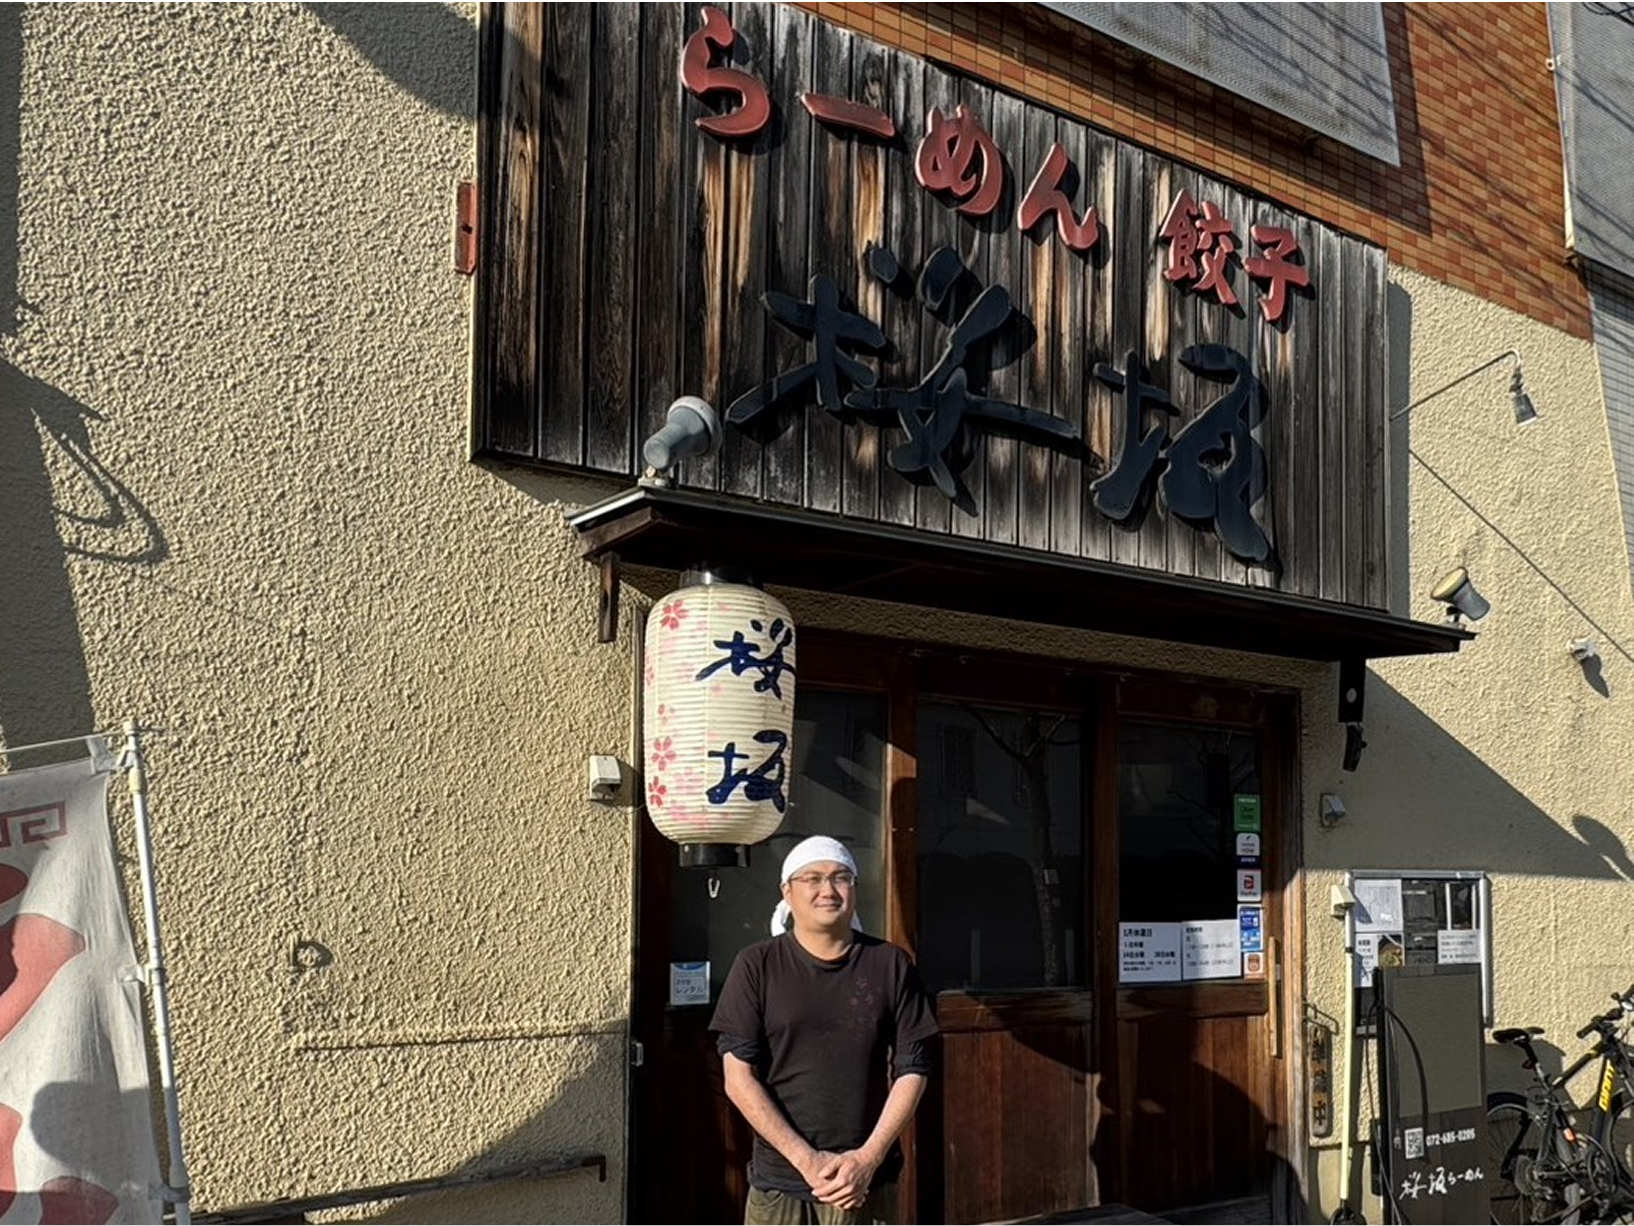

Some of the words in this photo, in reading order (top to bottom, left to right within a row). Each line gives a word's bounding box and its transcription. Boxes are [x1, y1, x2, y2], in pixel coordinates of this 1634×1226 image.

[681, 6, 1098, 250] らーめん
[1160, 187, 1310, 321] 餃子
